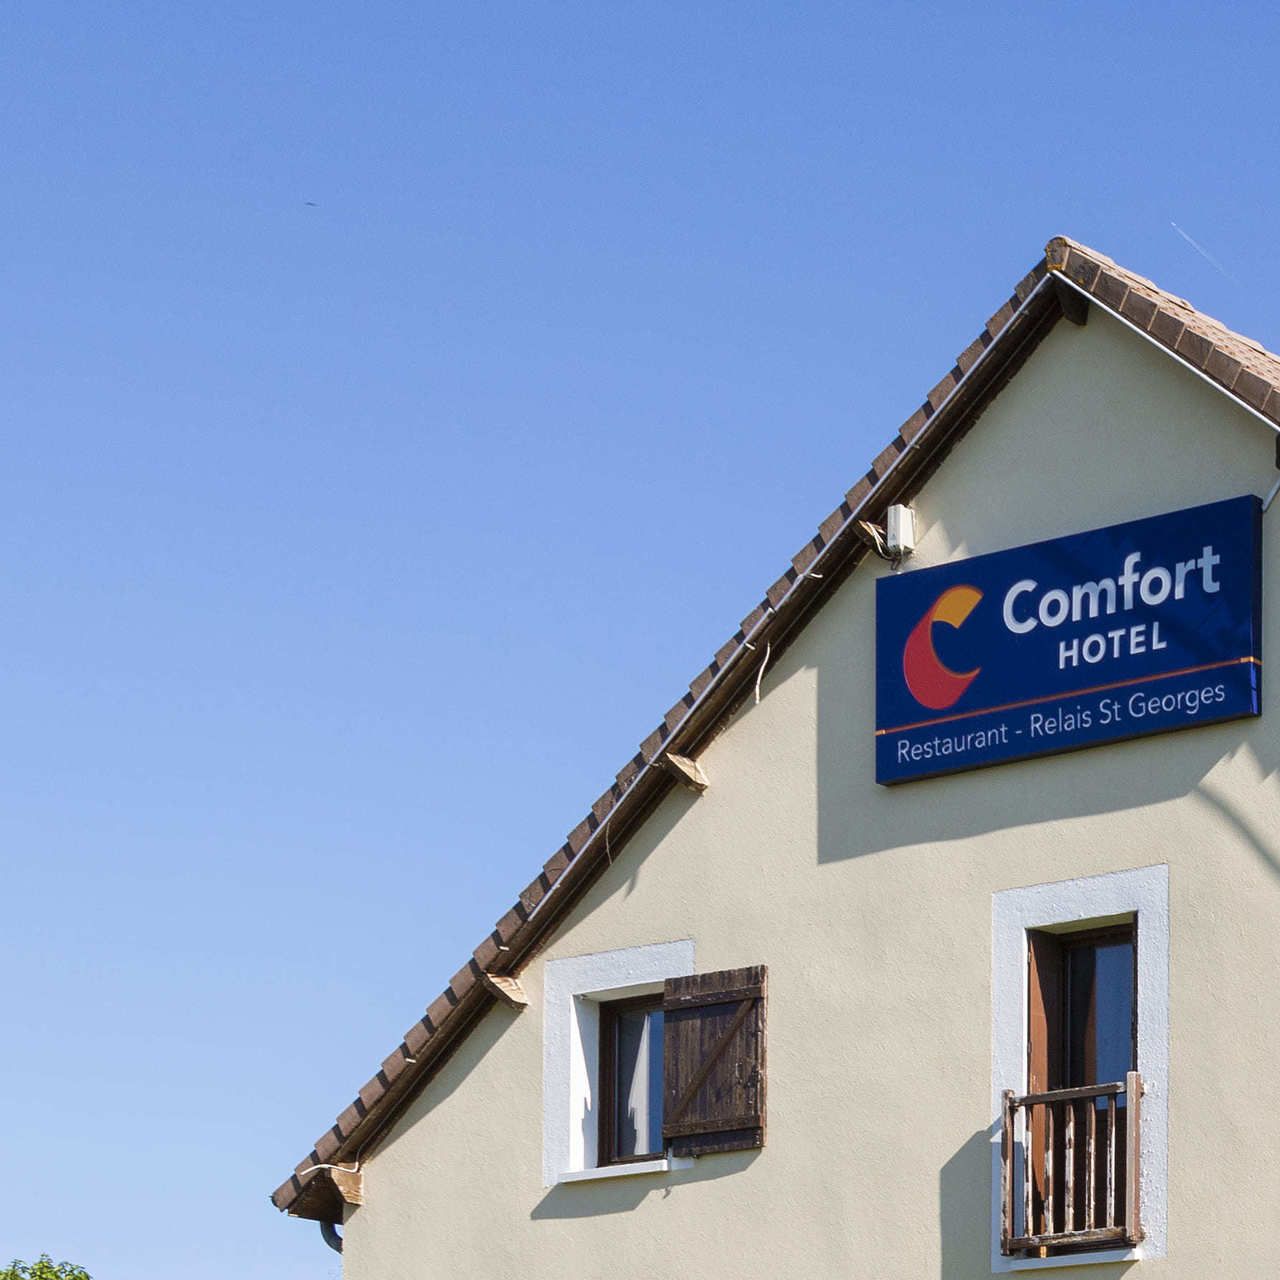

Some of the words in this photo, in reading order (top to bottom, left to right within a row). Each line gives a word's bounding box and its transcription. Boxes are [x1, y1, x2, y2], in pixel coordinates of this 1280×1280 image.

[1002, 545, 1221, 634] Comfort
[1058, 621, 1168, 669] HOTEL
[896, 723, 1009, 763] Restaurant
[1030, 705, 1093, 738] Relais
[1099, 699, 1122, 725] St
[1128, 684, 1226, 714] Georges
